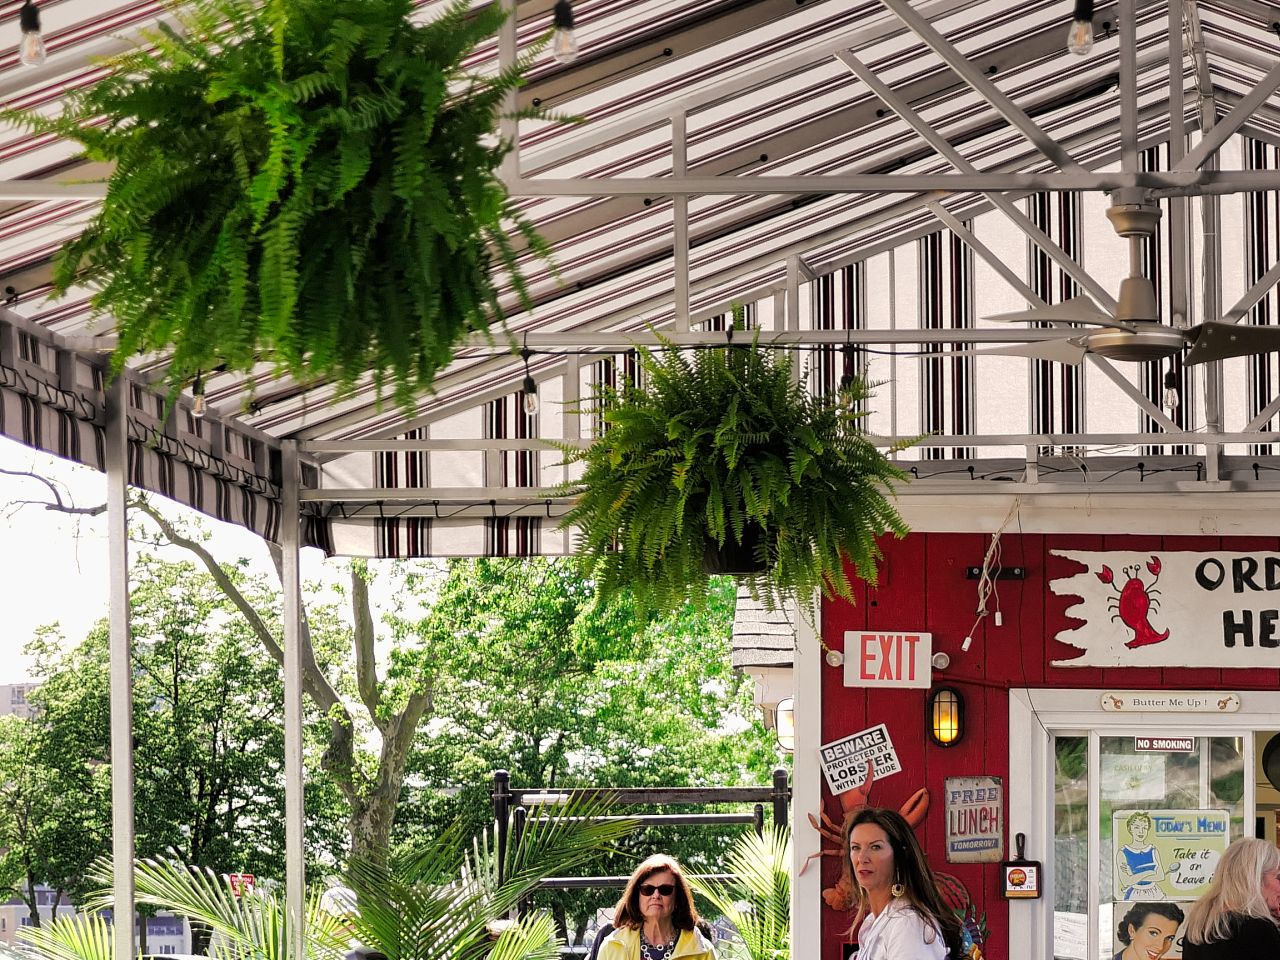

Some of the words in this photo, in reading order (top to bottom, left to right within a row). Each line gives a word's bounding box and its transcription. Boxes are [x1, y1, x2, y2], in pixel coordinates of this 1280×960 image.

[860, 634, 921, 681] EXIT
[1132, 698, 1166, 706] Butter
[1169, 698, 1183, 706] Me
[1187, 698, 1201, 708] Up
[823, 730, 884, 761] BEWARE
[1137, 739, 1150, 749] NO
[1152, 740, 1192, 749] SMOKING
[826, 749, 875, 772] PROTECTED
[877, 744, 889, 754] BY
[834, 779, 856, 791] WITH
[858, 764, 897, 783] ATTUDE
[950, 788, 999, 805] FREE
[950, 807, 999, 836] LUNCH
[954, 840, 995, 850] TOMORROW!
[1173, 848, 1197, 859] Take
[1200, 848, 1211, 859] it
[1190, 863, 1202, 871] or
[1175, 872, 1205, 884] Leave
[1208, 873, 1214, 884] i
